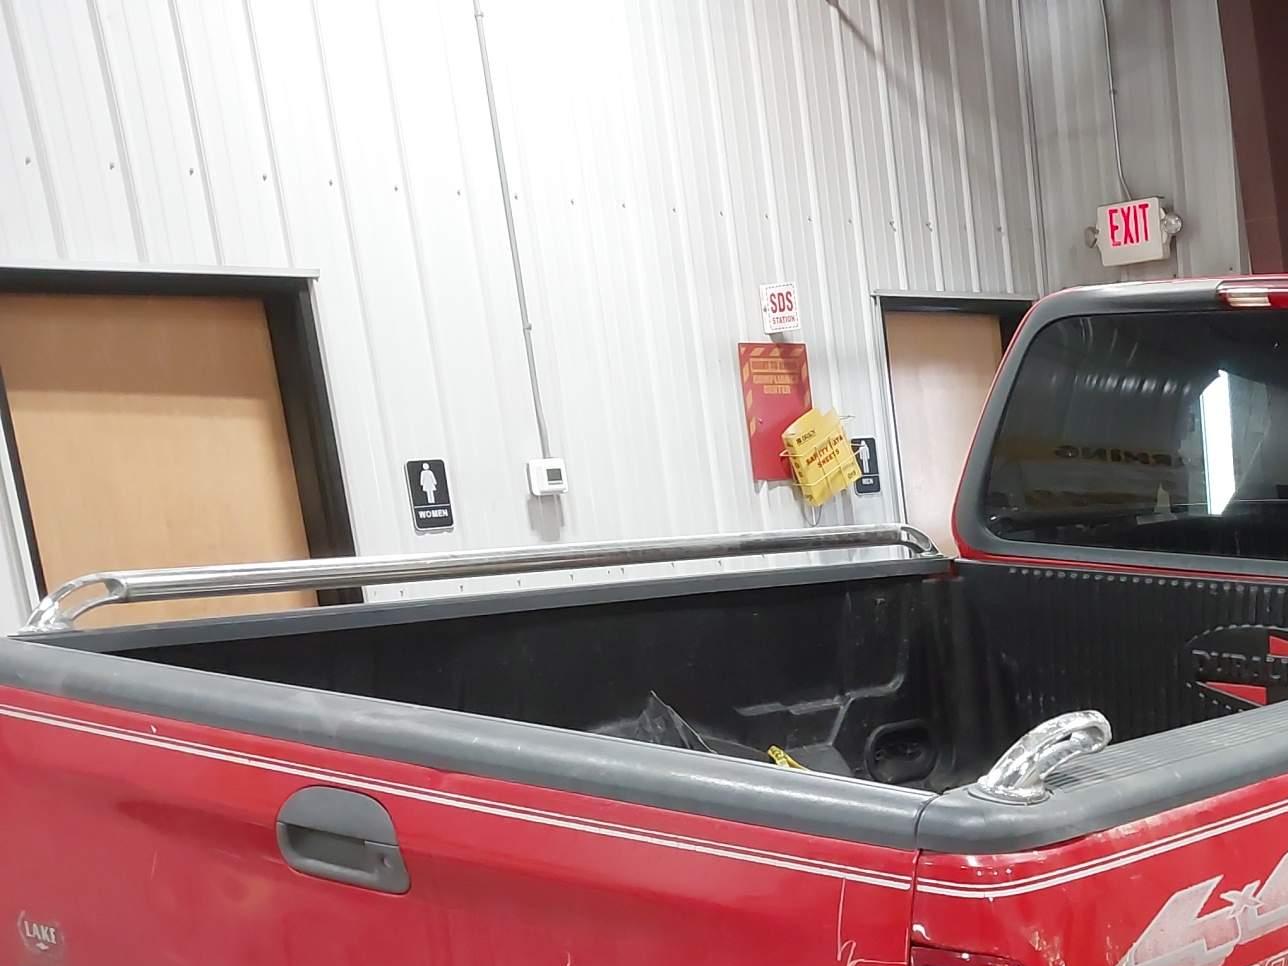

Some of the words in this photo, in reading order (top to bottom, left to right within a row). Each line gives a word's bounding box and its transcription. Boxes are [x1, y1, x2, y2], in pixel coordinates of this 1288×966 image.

[1108, 203, 1149, 247] EXIT
[769, 291, 794, 314] SDS
[772, 315, 796, 325] STATION
[418, 508, 449, 519] WOMEN
